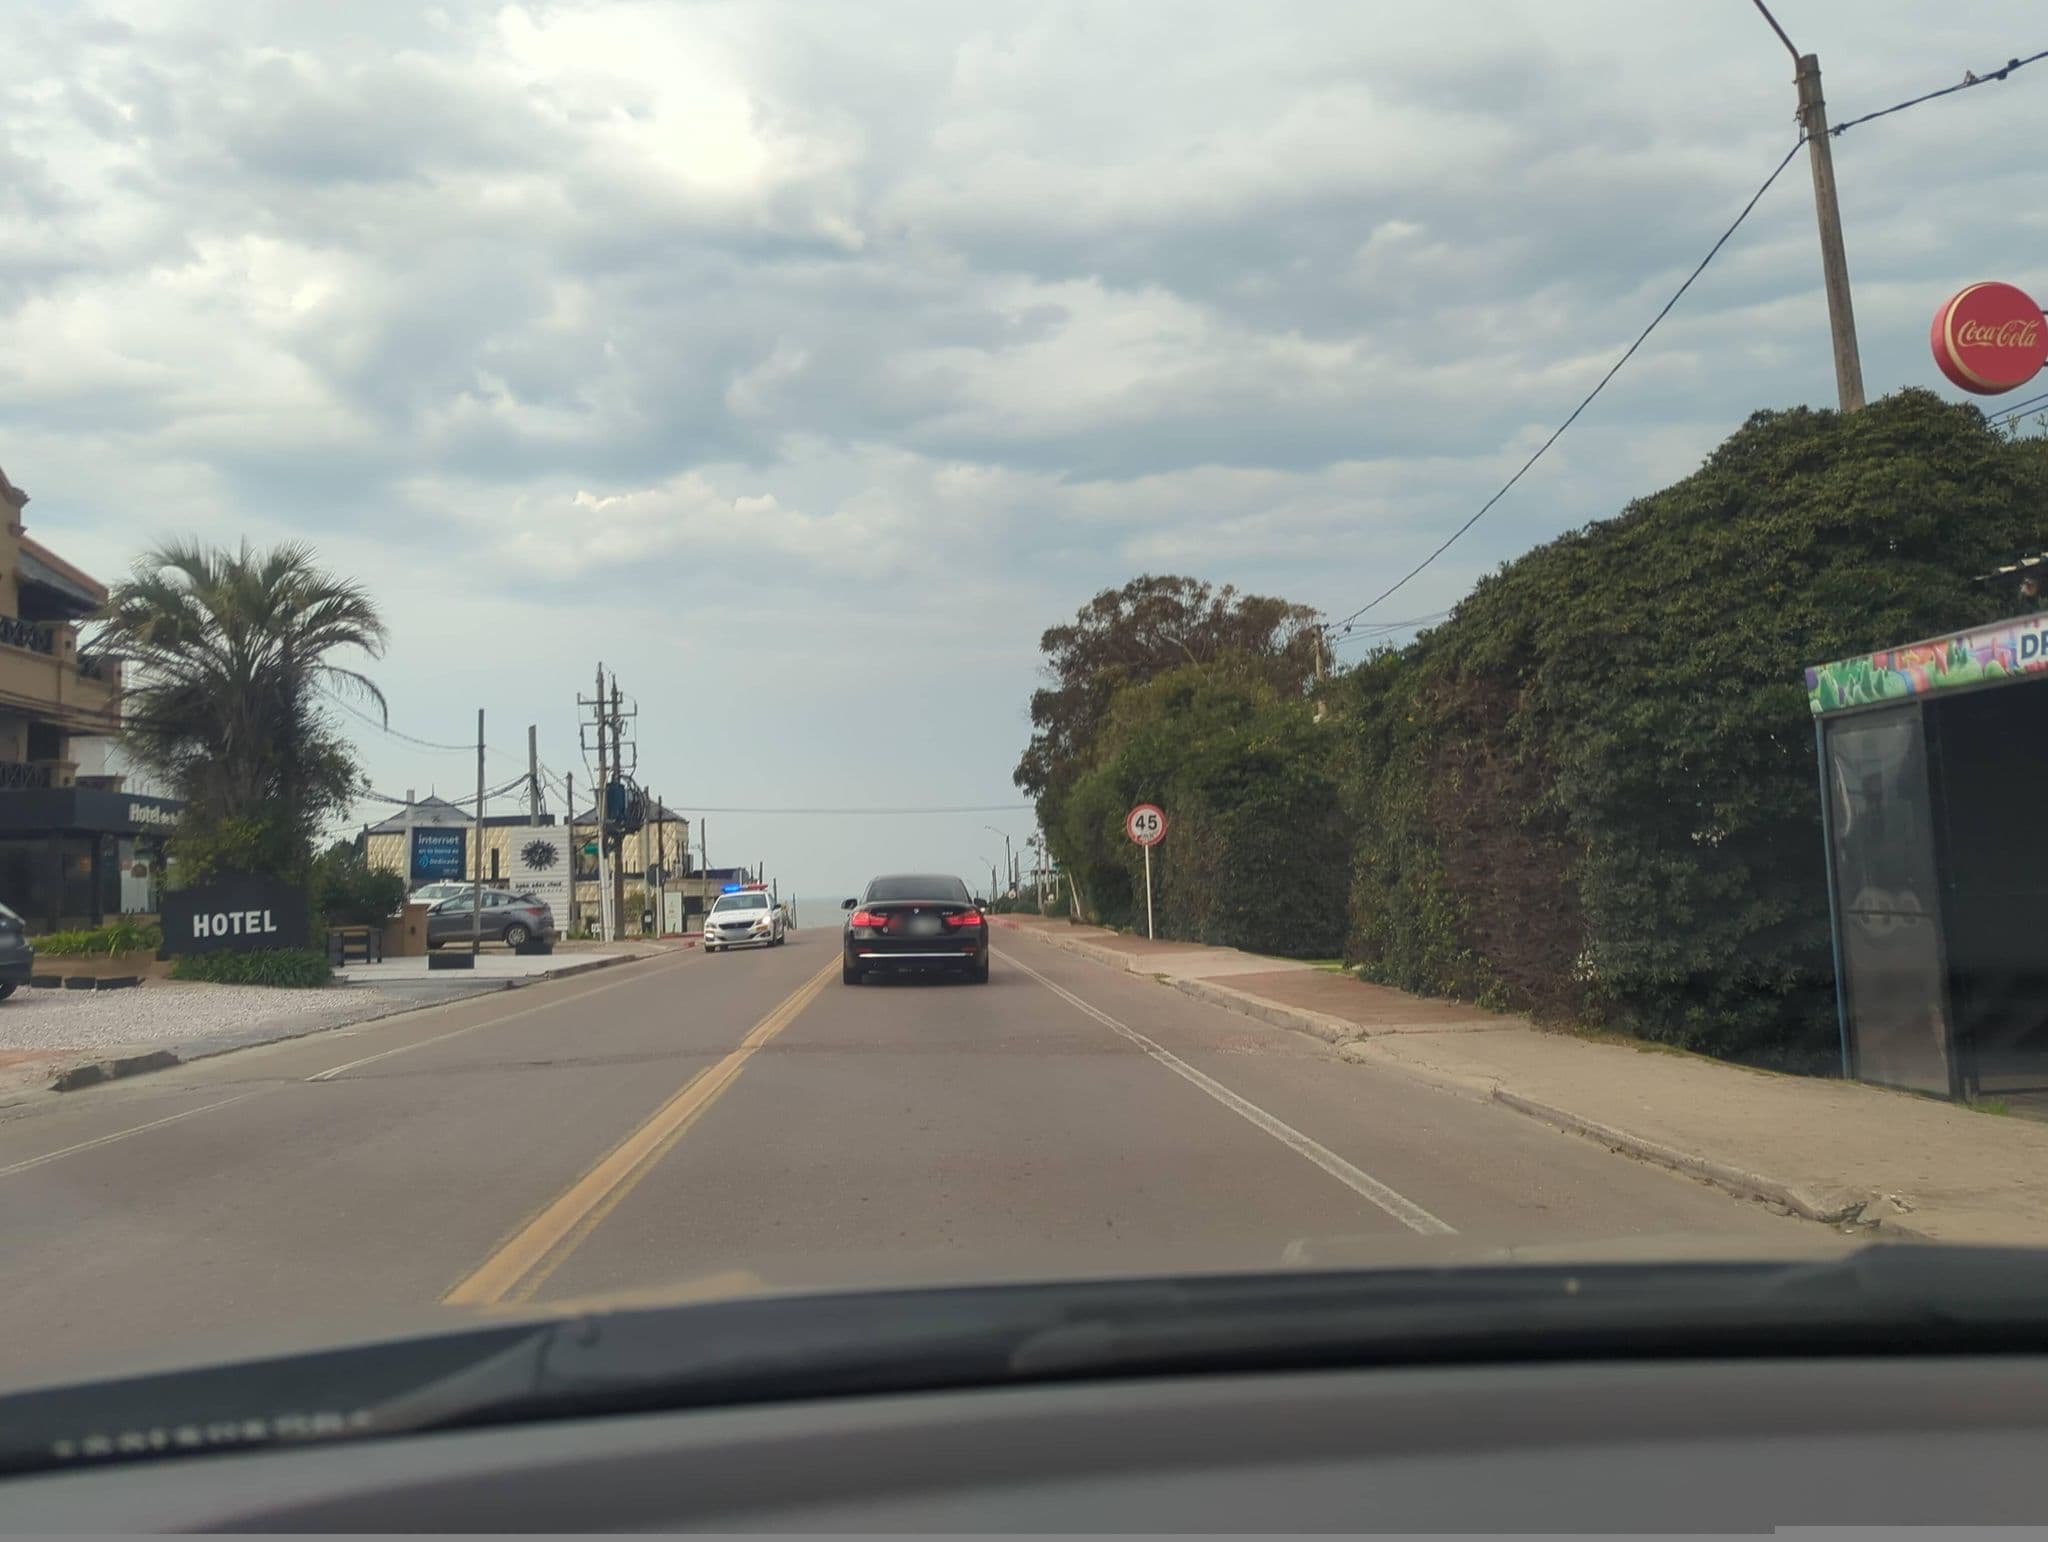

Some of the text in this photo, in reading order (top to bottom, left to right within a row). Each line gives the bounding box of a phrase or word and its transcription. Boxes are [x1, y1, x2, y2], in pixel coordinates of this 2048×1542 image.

[129, 804, 160, 823] Hotel
[1135, 815, 1157, 830] 45
[193, 909, 277, 938] HOTEL
